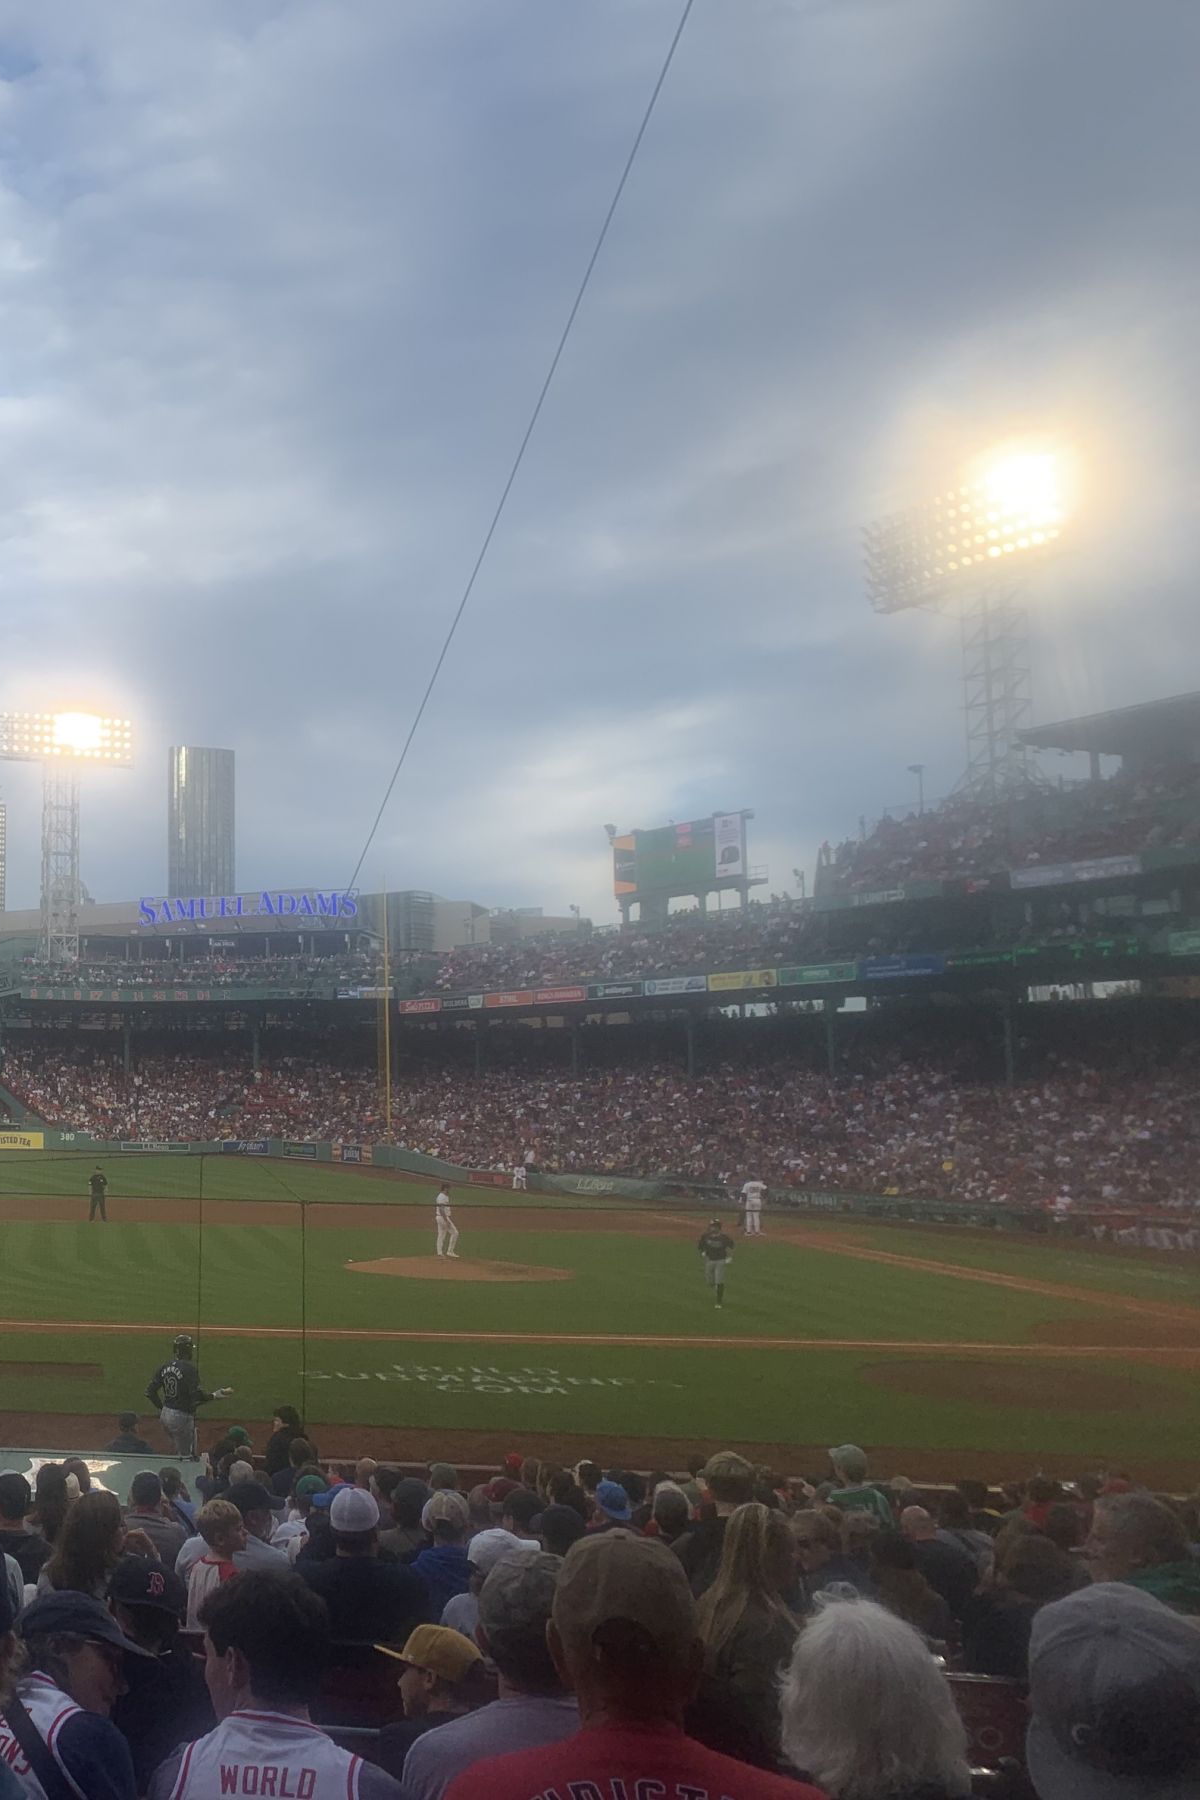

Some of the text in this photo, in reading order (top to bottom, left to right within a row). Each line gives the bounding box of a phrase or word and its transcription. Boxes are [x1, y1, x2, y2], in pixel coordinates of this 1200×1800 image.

[138, 890, 358, 927] SAMUEL ADAMS
[19, 1137, 31, 1147] TEA
[60, 1132, 75, 1141] 380
[220, 1764, 317, 1799] WORLD
